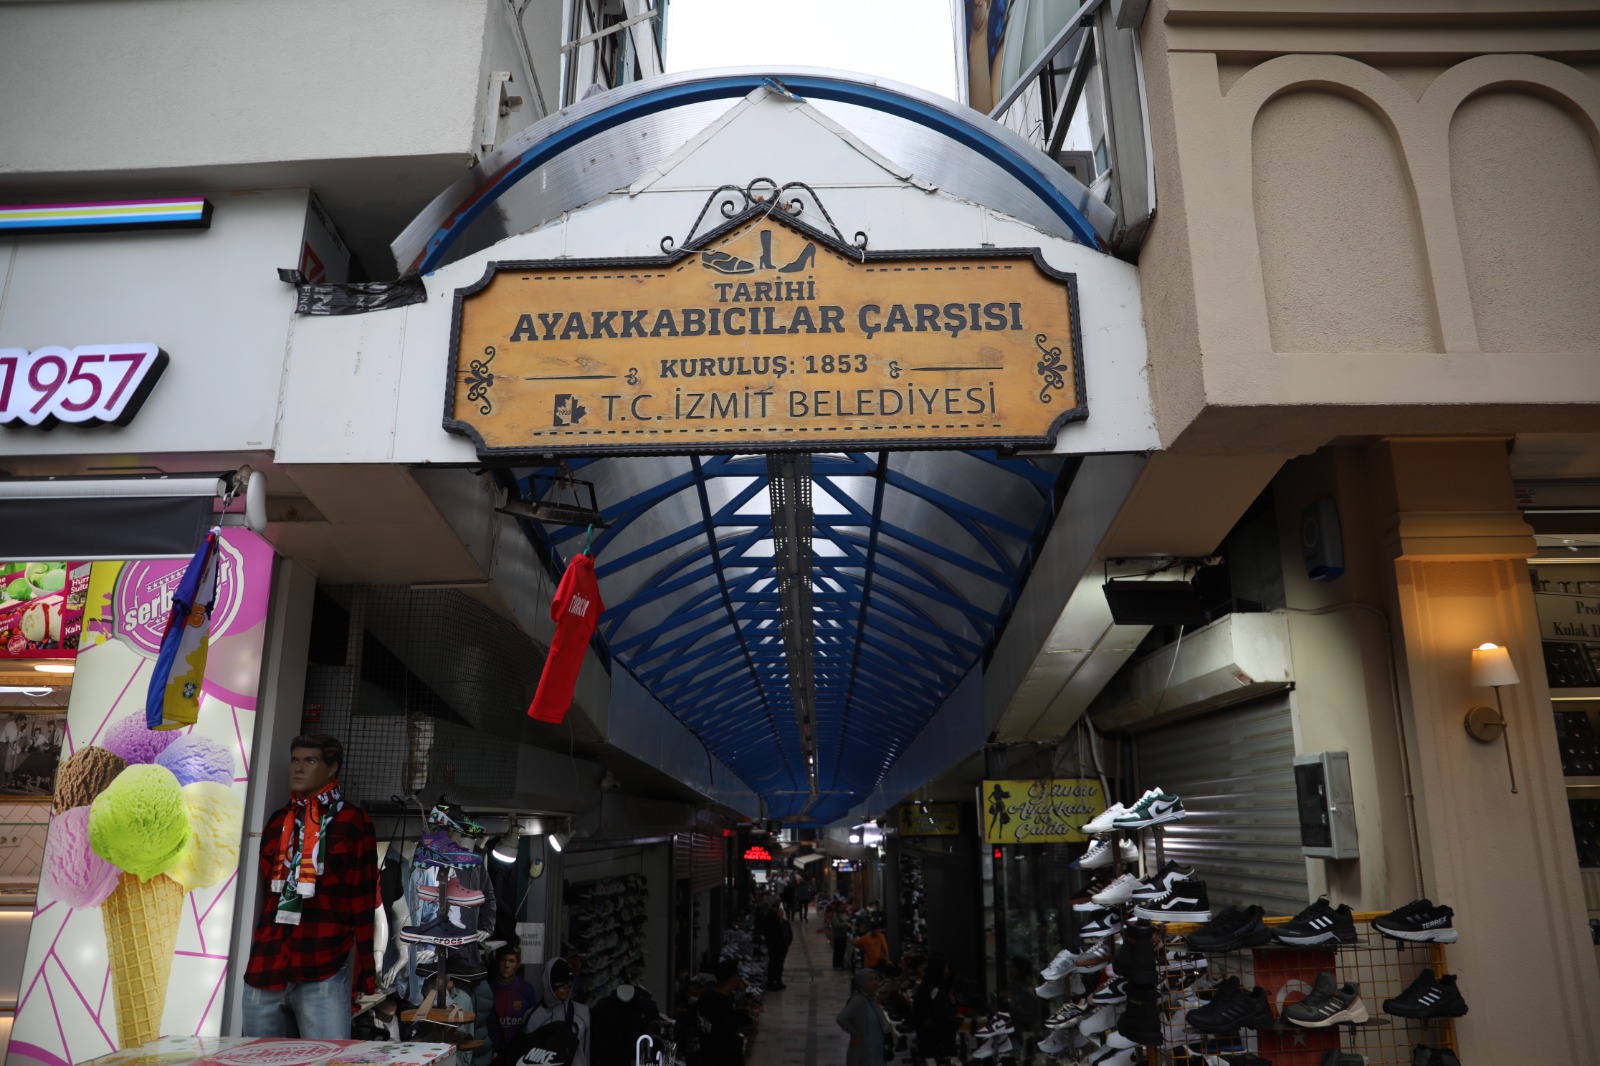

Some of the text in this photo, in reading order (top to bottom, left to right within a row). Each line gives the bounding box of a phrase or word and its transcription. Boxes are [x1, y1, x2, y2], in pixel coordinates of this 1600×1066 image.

[714, 276, 815, 302] TARİHİ
[509, 302, 1024, 342] AYAKKABICILAR ÇARŞISI
[660, 354, 869, 379] KURULUŞ: 1853
[0, 352, 147, 415] 1957
[601, 381, 997, 422] T.C. İZMİT BELEDİYESİ
[1552, 622, 1589, 637] Kulak
[1421, 915, 1447, 930] TERREX
[524, 1047, 558, 1064] NIKE
